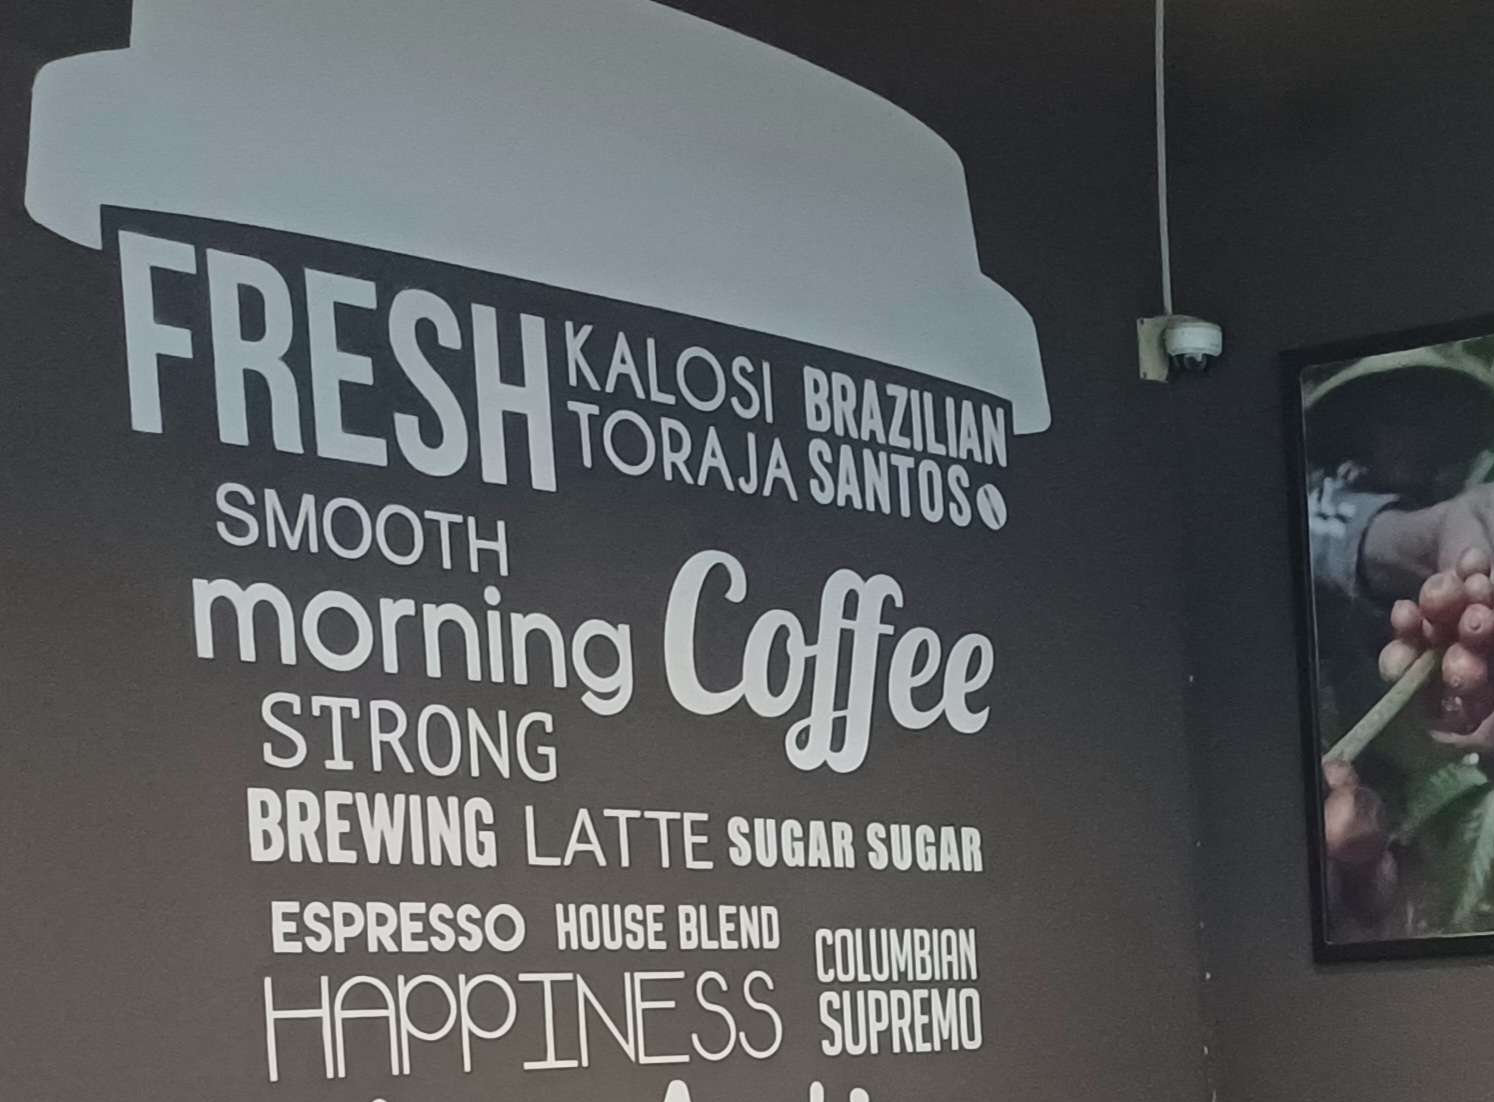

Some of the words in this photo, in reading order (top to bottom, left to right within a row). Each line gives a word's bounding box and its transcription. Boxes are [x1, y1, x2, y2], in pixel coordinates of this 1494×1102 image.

[119, 231, 556, 491] FRESH
[564, 319, 774, 423] KALOSI
[566, 400, 798, 501] TORAJA
[803, 365, 1007, 468] BRAZILIAN
[216, 482, 508, 576] SMOOTH
[808, 438, 972, 527] SANTOS
[191, 578, 634, 716] morning
[663, 549, 995, 774] Coffee
[261, 691, 557, 782] STRONG
[246, 787, 498, 869] BREWING
[525, 804, 714, 870] LATTE
[727, 815, 856, 869] SUGAR
[866, 822, 983, 872] SUGAR
[270, 900, 526, 954] ESPRESSO
[555, 902, 668, 951] HOUSE
[677, 904, 780, 951] BLEND
[814, 927, 978, 983] COLUMBIAN
[263, 970, 783, 1082] HAPPINESS
[819, 987, 983, 1056] SUPREMO
